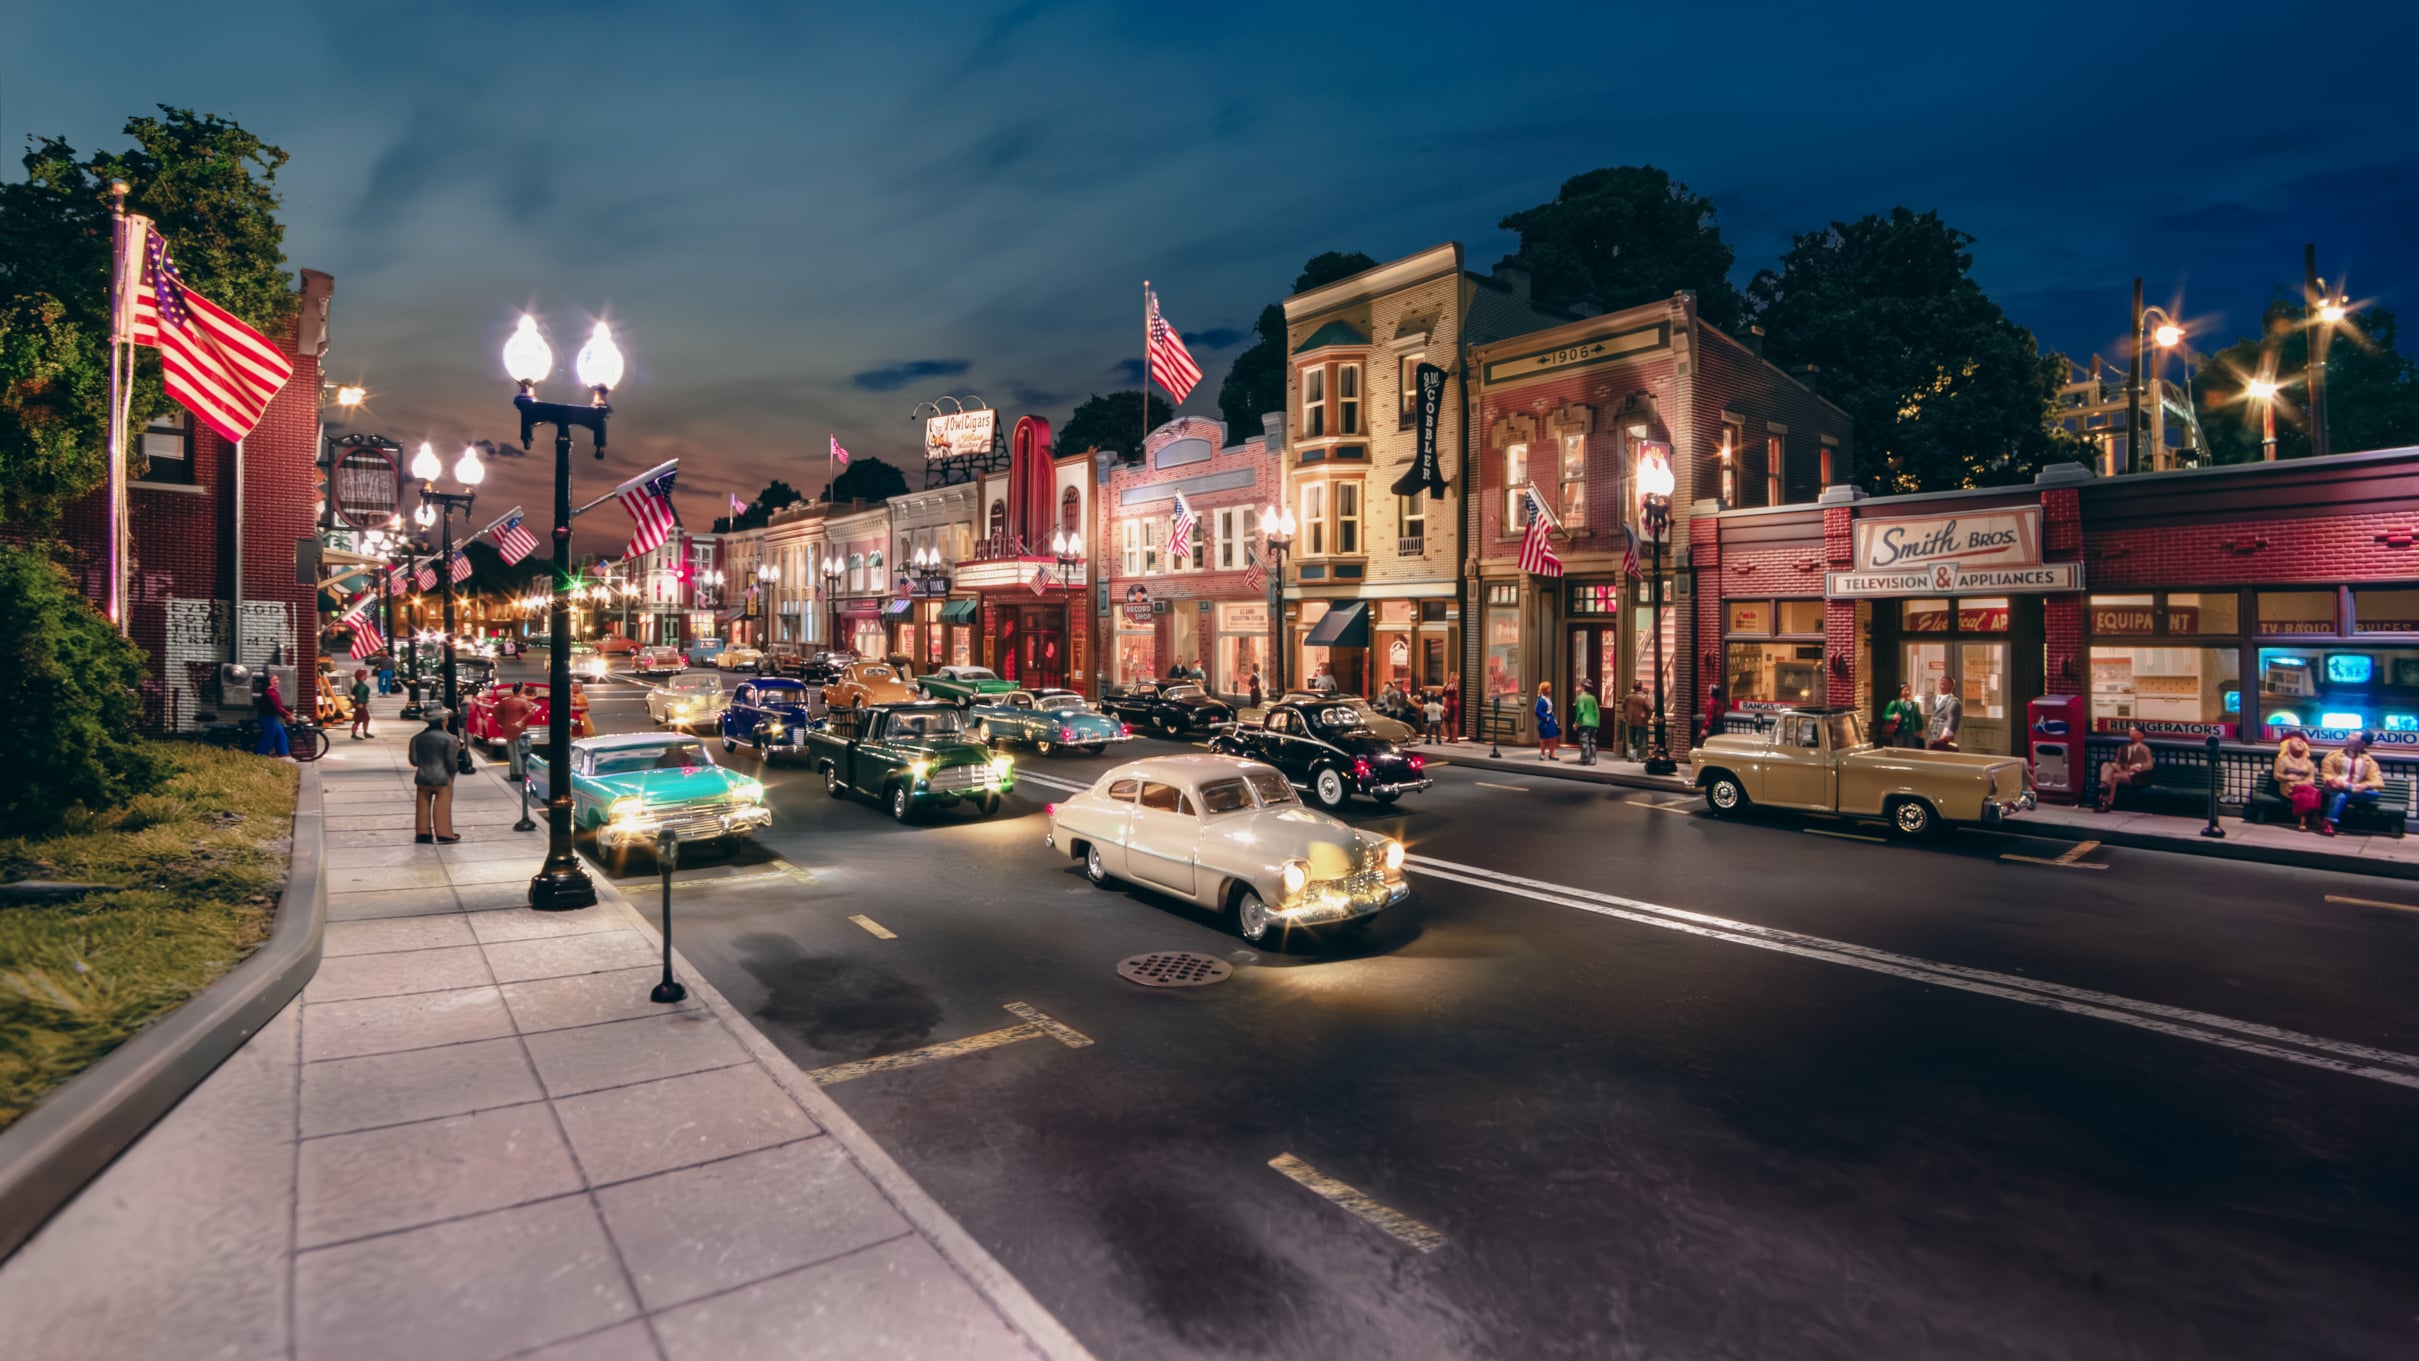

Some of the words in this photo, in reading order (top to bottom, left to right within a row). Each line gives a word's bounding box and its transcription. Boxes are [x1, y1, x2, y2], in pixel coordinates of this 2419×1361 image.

[1552, 346, 1589, 365] 1906
[1422, 389, 1436, 480] COBBLER
[1872, 520, 1961, 567] Smith
[1968, 530, 2017, 548] BROS.
[1844, 576, 1928, 589] TELEVISION
[1935, 566, 1952, 588] &
[1959, 571, 2054, 586] APPLIANCES
[1126, 605, 1151, 613] RECORD
[1918, 611, 1987, 631] Elecical
[2097, 612, 2190, 631] EQUIPMNT
[2285, 623, 2330, 633] RADIO
[2356, 623, 2413, 632] RVICES
[1742, 701, 1775, 710] RANGES
[2278, 727, 2348, 741] TVISIO
[2376, 732, 2417, 744] ADIO
